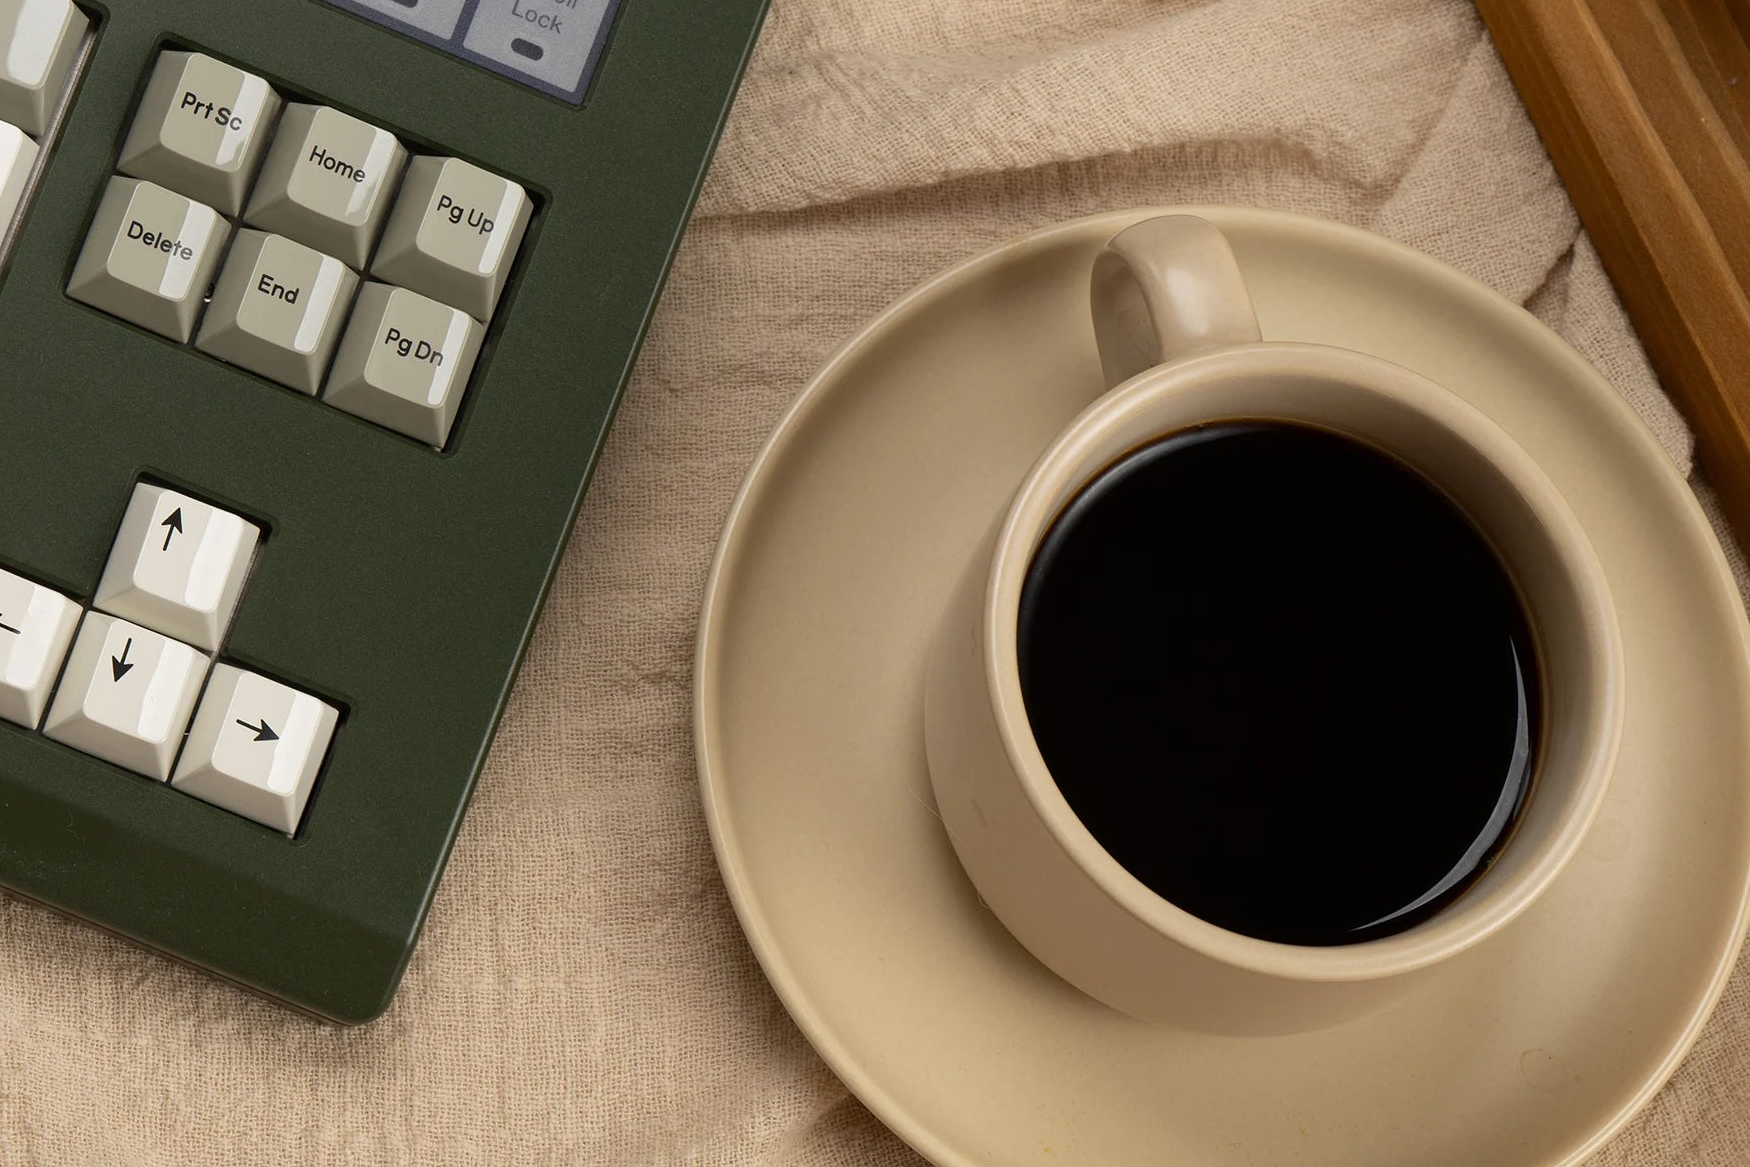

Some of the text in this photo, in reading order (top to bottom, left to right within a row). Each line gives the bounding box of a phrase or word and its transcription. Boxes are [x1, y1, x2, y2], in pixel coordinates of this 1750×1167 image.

[511, 0, 562, 34] Lock
[309, 145, 365, 182] Home
[127, 221, 192, 260] Delete
[258, 274, 299, 304] End
